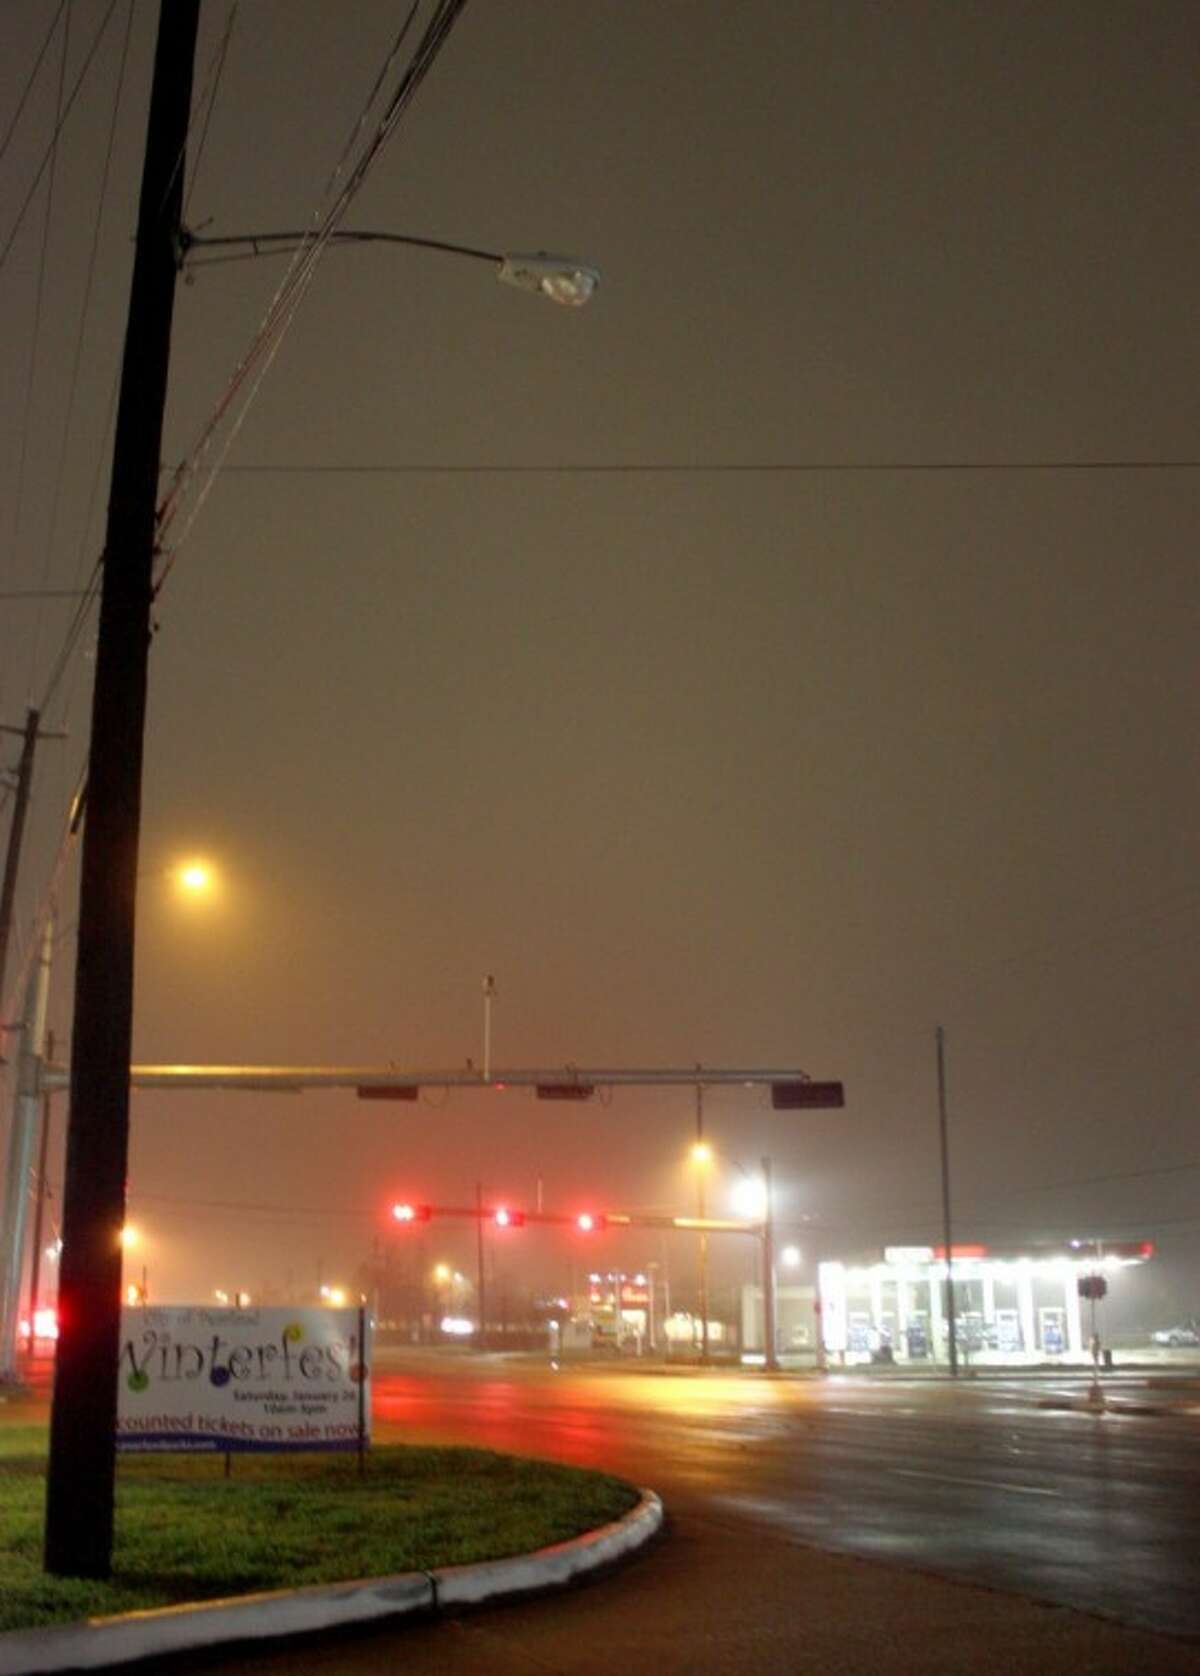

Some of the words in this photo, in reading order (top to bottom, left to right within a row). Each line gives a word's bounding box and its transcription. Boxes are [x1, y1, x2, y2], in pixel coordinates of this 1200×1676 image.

[293, 1390, 338, 1403] January
[198, 1413, 254, 1436] tickets
[259, 1424, 282, 1437] on
[287, 1421, 321, 1437] sale
